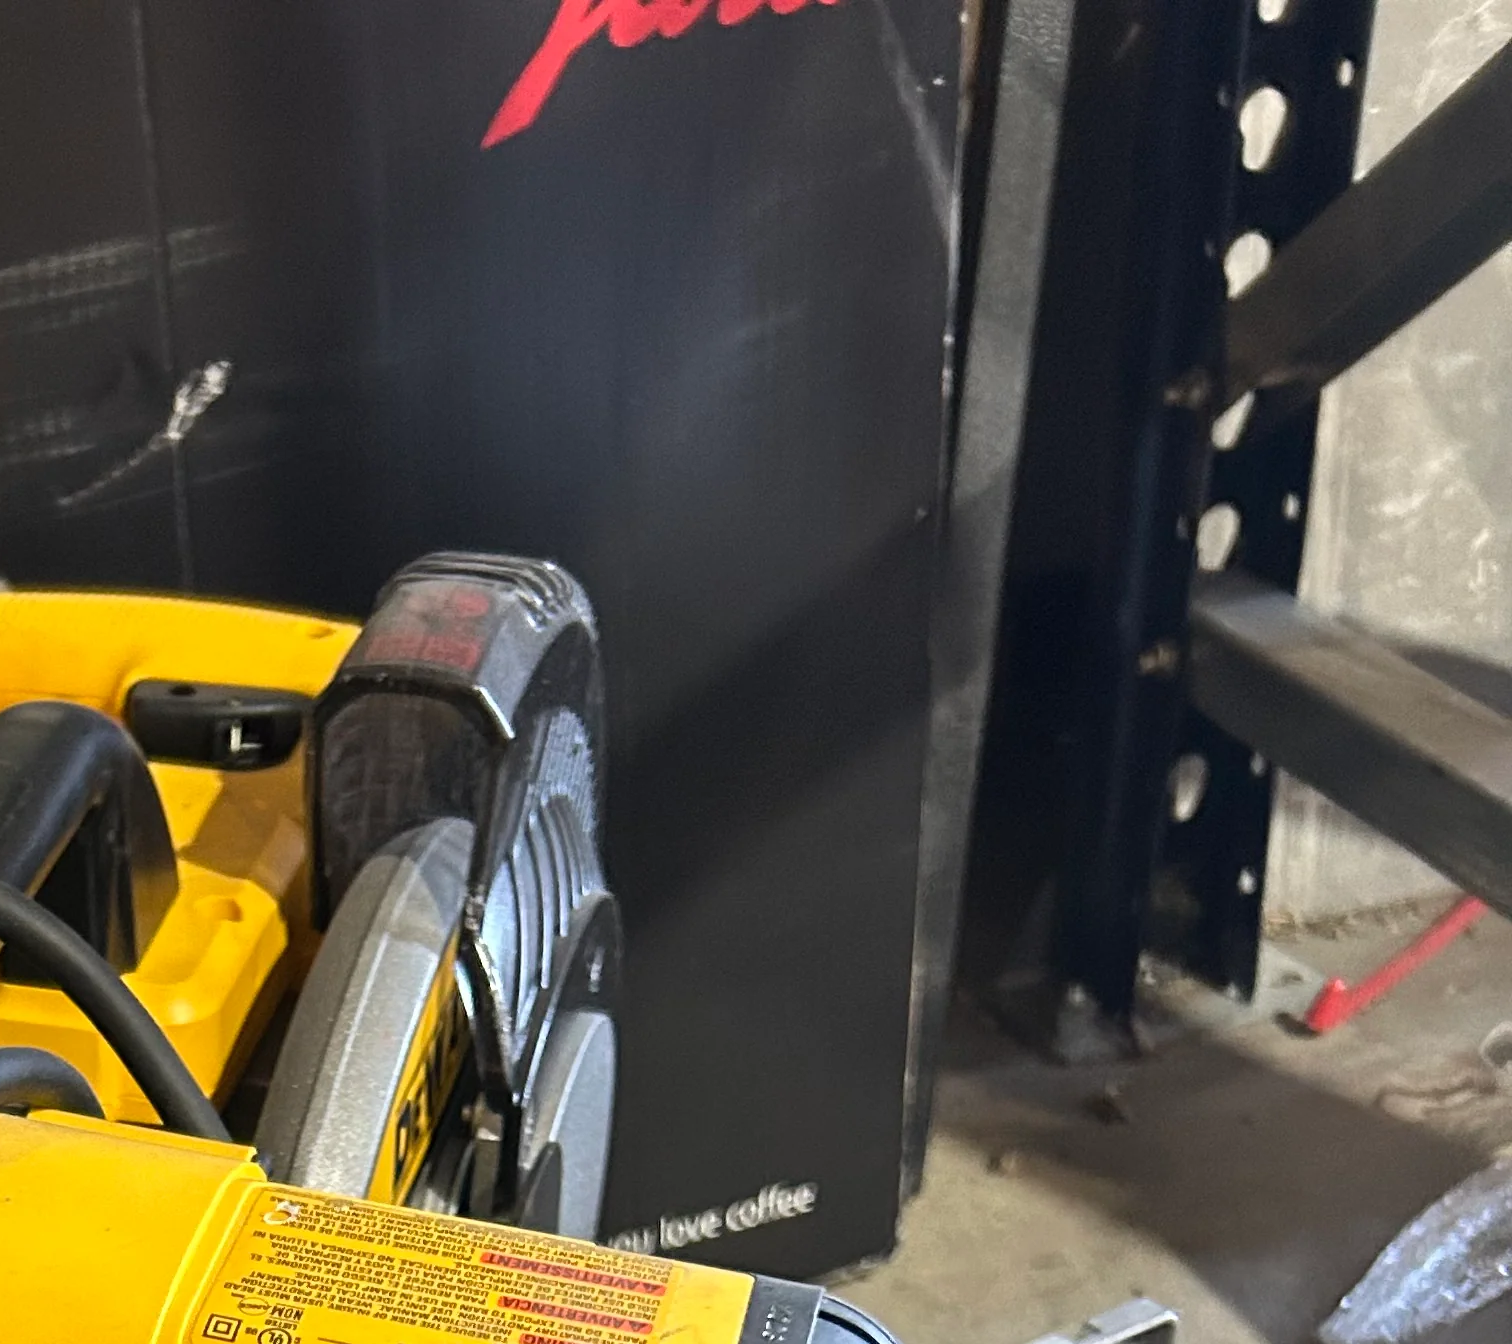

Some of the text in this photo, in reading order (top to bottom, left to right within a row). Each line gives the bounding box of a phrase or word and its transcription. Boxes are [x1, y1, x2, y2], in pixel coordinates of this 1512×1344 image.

[660, 1206, 723, 1250] love
[725, 1181, 819, 1233] coffee
[482, 1250, 640, 1294] AVERTISSEMENT
[269, 1304, 303, 1320] NOM
[499, 1295, 625, 1329] ADVERTENCIA
